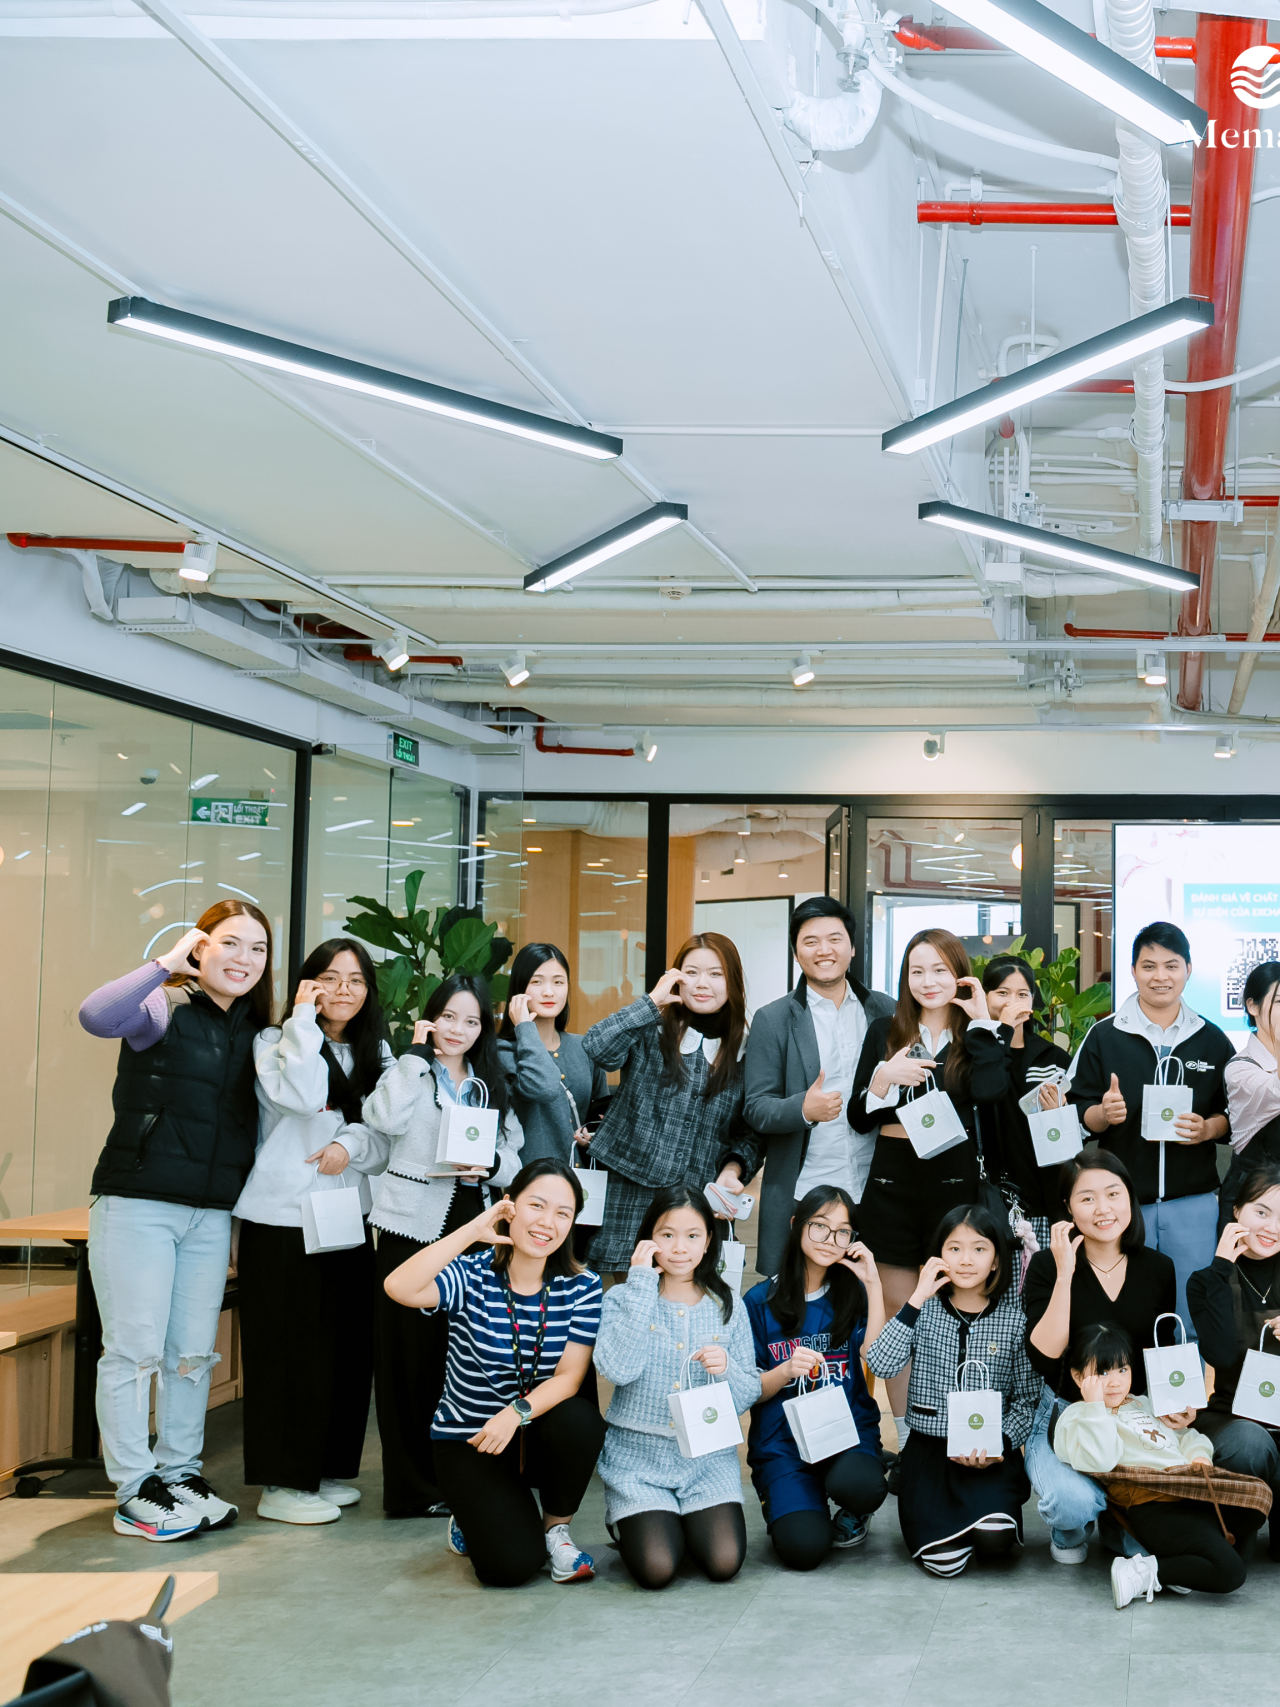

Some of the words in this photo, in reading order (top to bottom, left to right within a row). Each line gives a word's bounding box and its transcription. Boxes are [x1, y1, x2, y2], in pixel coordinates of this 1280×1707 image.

[399, 737, 413, 751] EXIT
[235, 814, 260, 824] EXIT
[1191, 892, 1219, 902] ĐÁNH
[1221, 892, 1238, 902] GIÁ
[1253, 891, 1278, 902] CHẤT
[1230, 906, 1250, 916] CỦA
